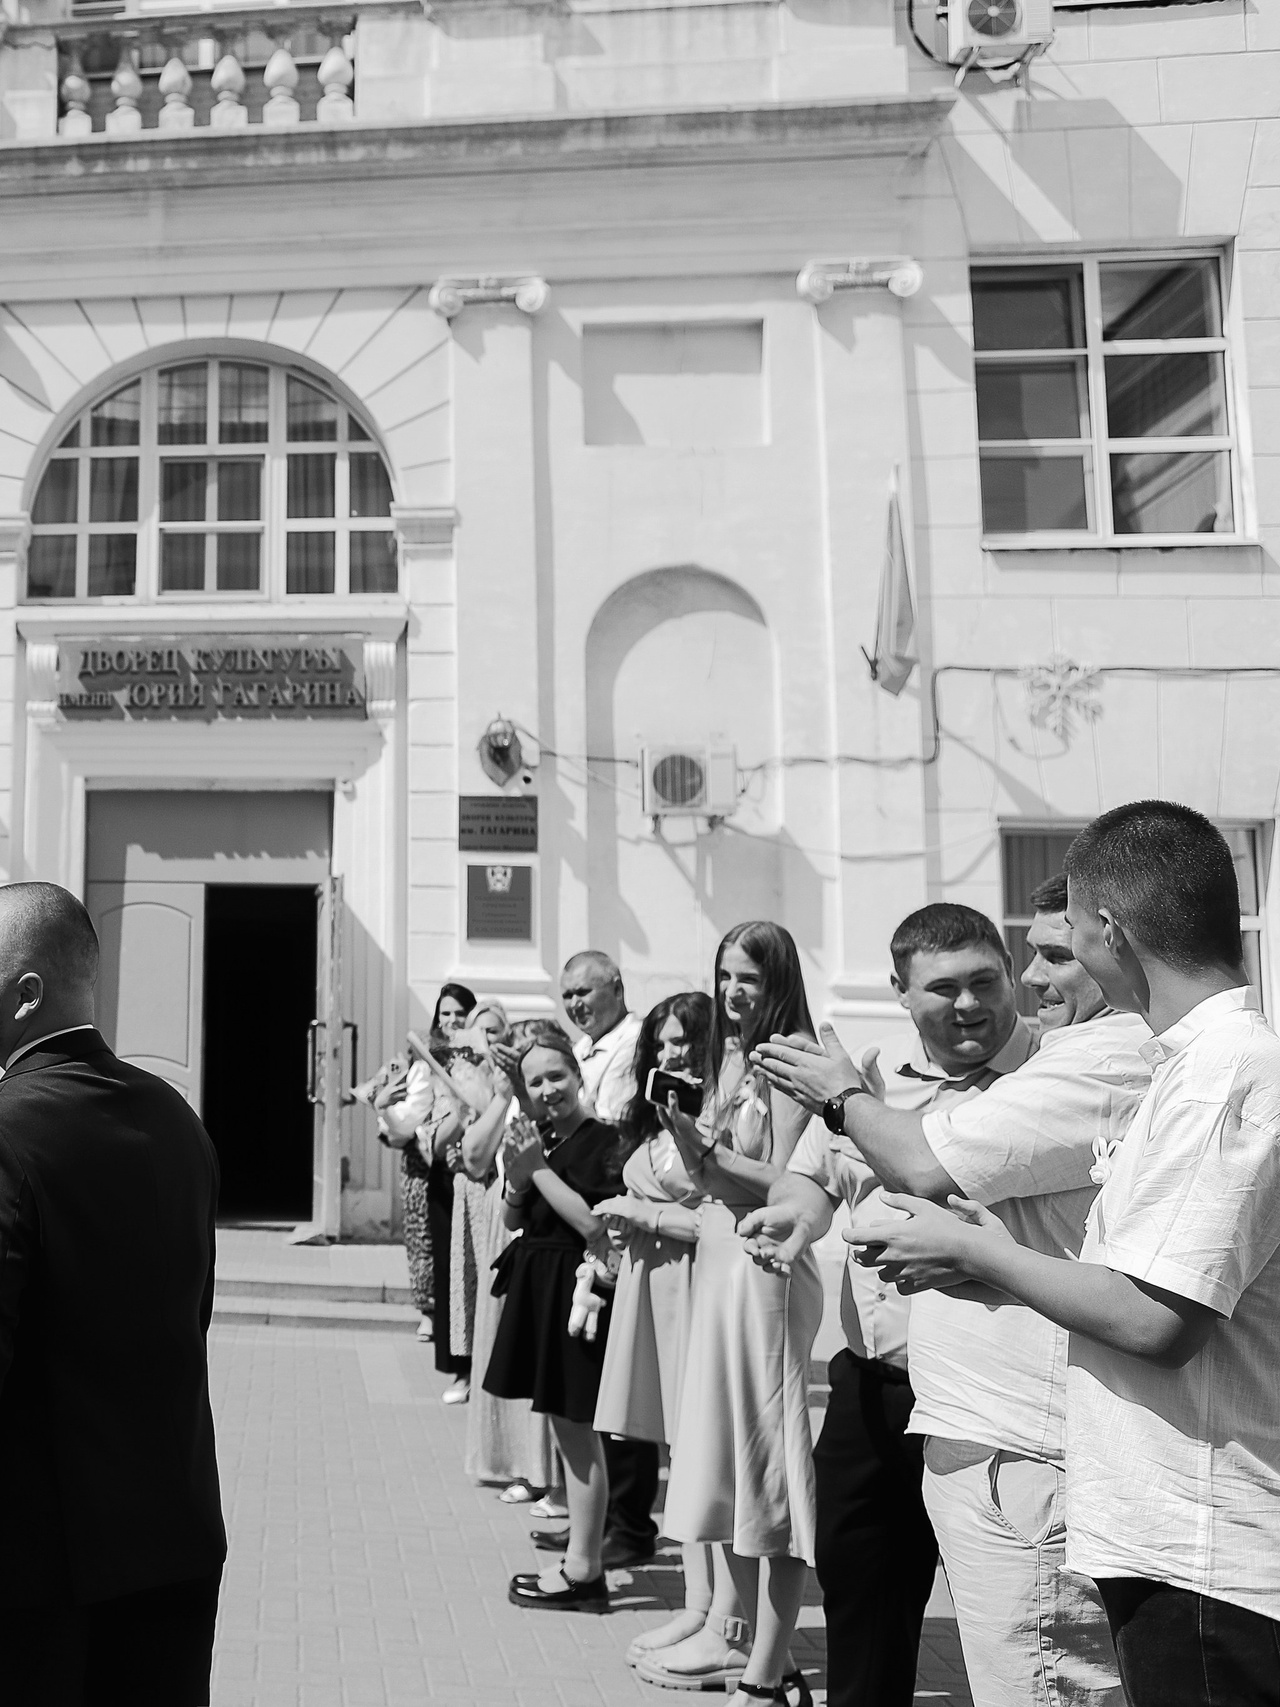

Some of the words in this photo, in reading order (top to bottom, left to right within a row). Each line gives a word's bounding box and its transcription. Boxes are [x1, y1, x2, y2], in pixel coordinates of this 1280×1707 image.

[79, 649, 181, 677] ДВОРЕЦ
[190, 648, 342, 673] КУЛЬТУРЫ
[125, 682, 205, 707] ЮРИЯ
[215, 681, 365, 706] ГАГАРИНА
[480, 826, 536, 836] ГАГАРИНА
